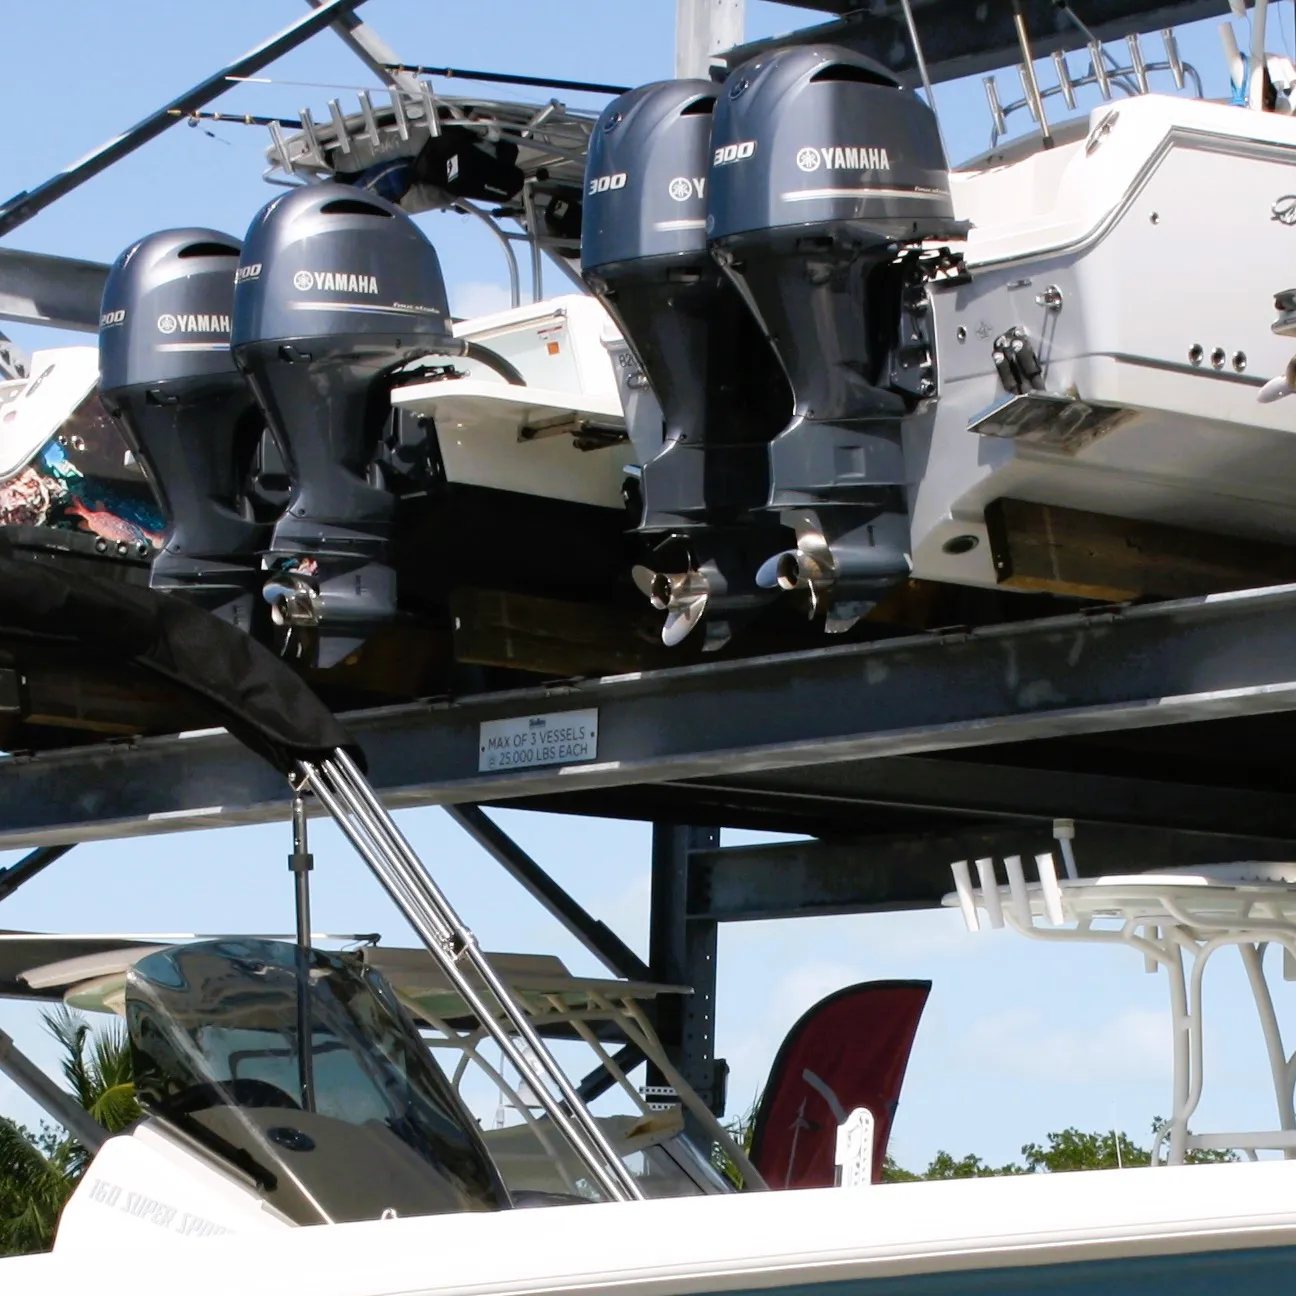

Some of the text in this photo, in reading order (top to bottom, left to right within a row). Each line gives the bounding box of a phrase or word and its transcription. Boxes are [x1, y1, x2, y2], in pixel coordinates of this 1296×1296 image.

[713, 141, 757, 166] 300
[820, 147, 891, 170] YAMAHA
[588, 173, 628, 196] 300
[314, 271, 379, 295] YAMAHA
[176, 313, 231, 333] YAMAH
[488, 725, 586, 751] MAX OF 3 VESSELS
[536, 745, 556, 762] LBS
[558, 742, 589, 759] EACH
[89, 1178, 122, 1208] 160
[120, 1190, 178, 1230] SUPER
